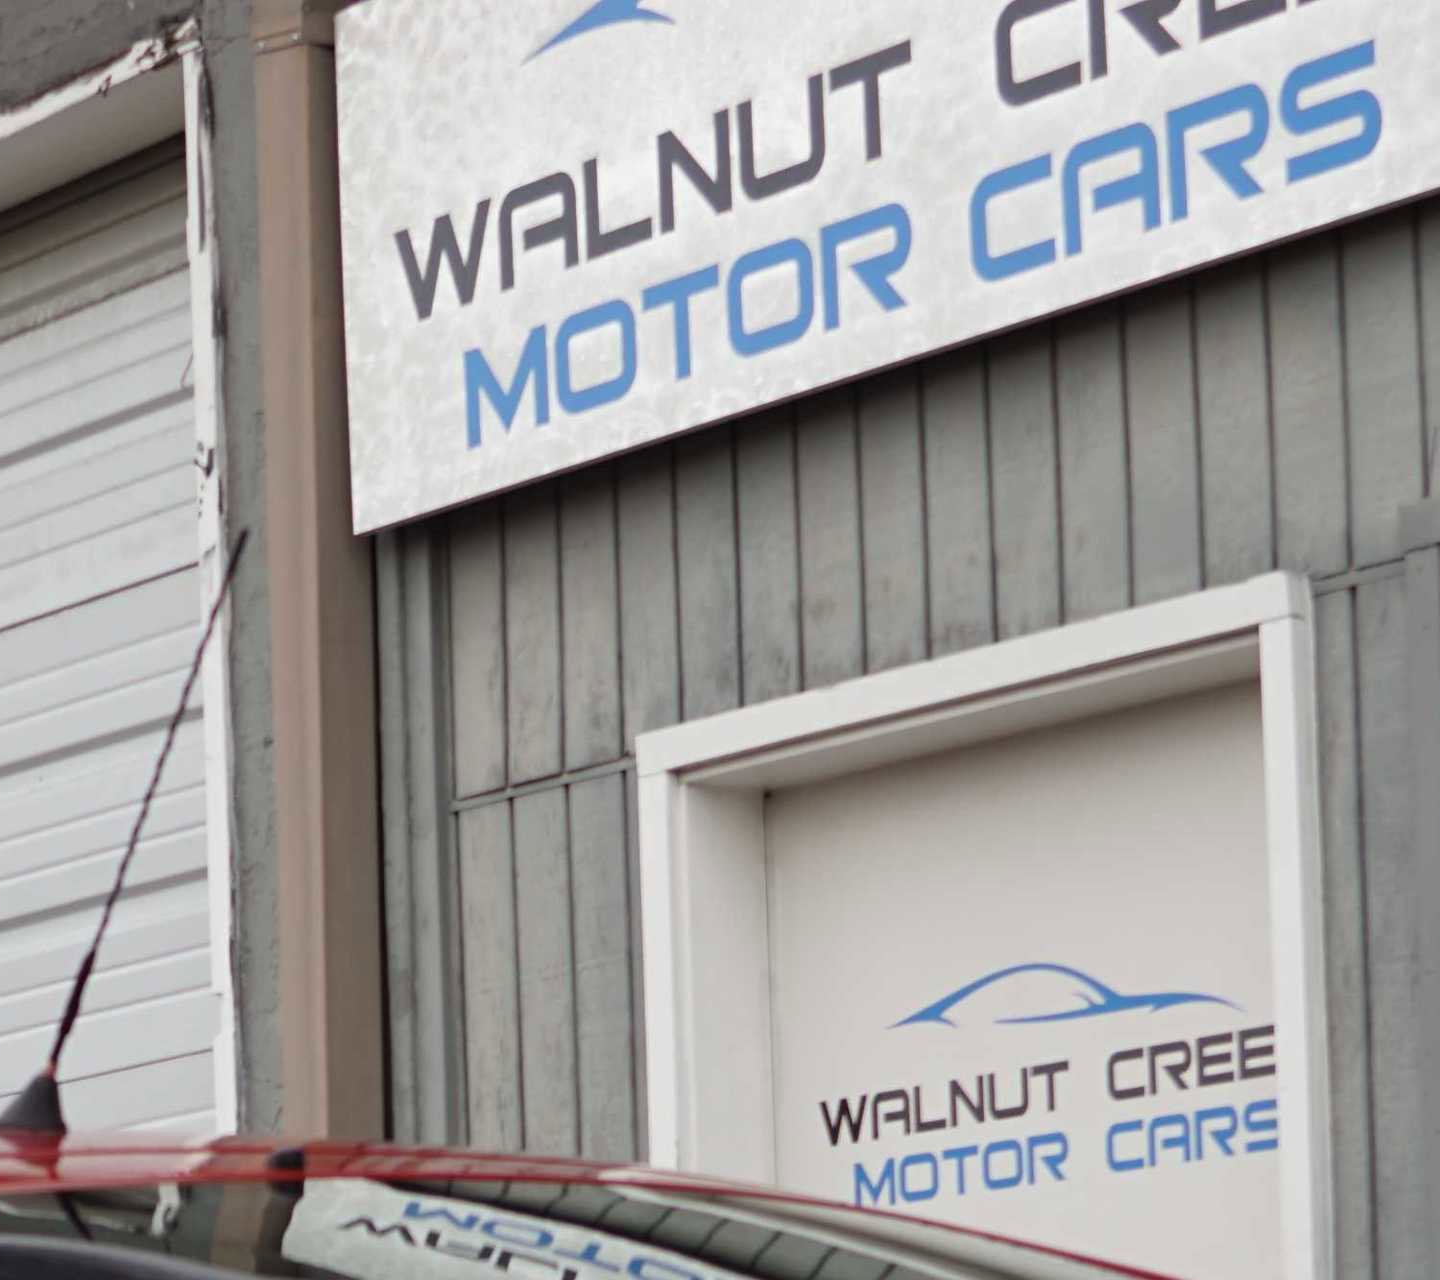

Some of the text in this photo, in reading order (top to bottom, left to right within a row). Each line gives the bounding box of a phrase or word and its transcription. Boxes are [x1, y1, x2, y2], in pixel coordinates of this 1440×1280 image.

[394, 39, 912, 320] WALNUT
[462, 202, 912, 450] MOTOR
[968, 40, 1384, 283] CARS
[819, 1024, 1277, 1147] WALNUT CREE
[852, 1098, 1280, 1207] MOTOR CARS
